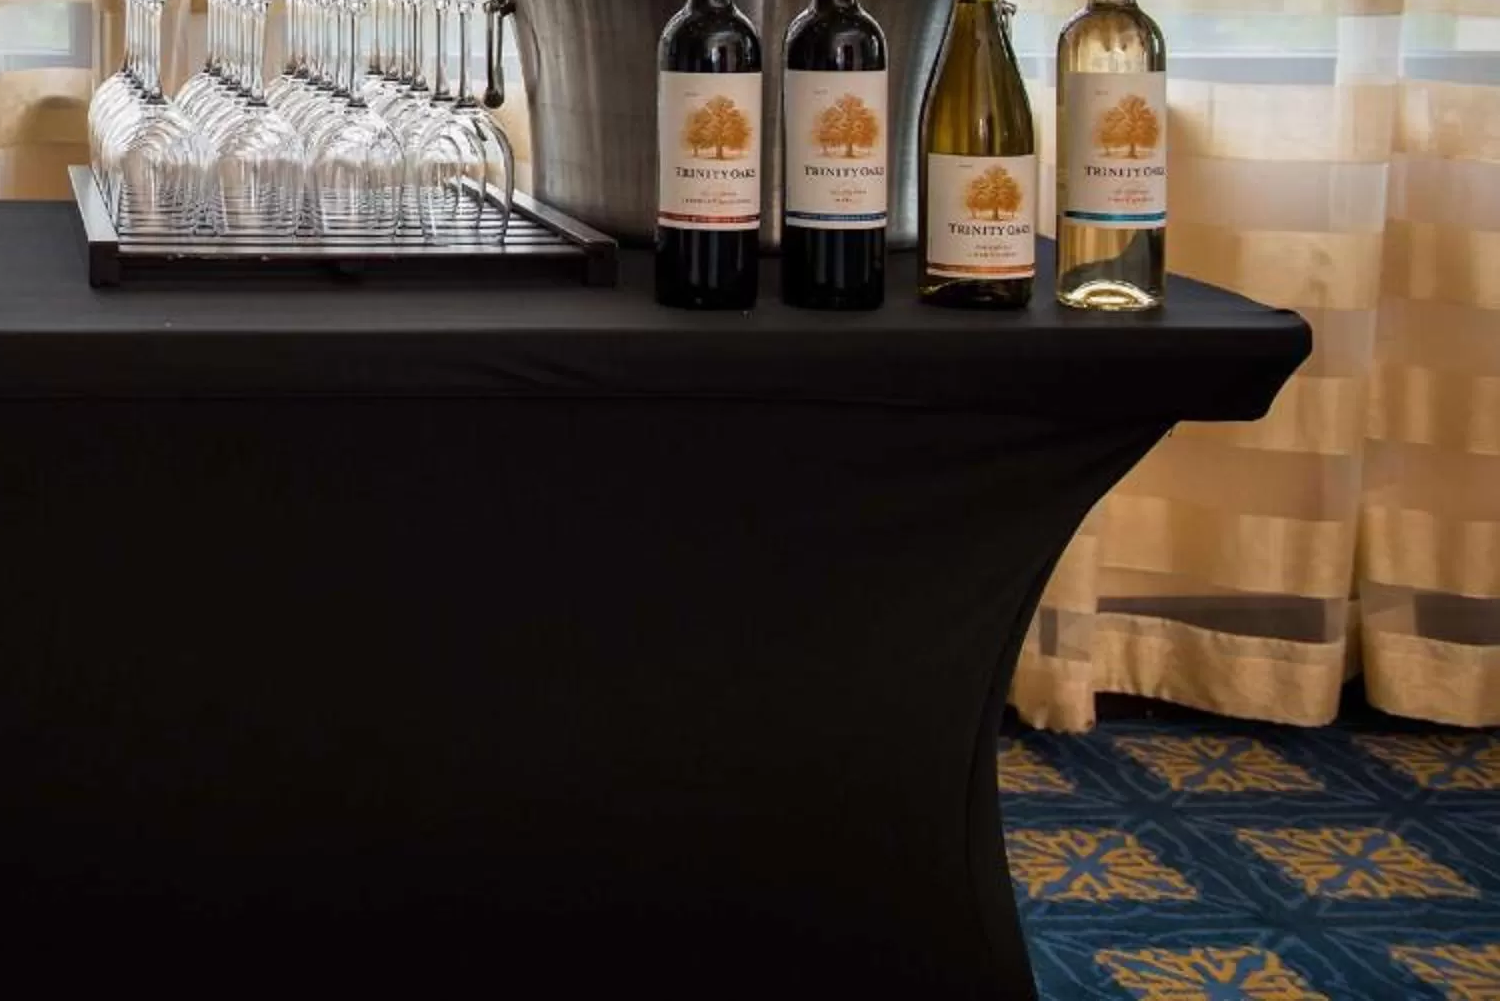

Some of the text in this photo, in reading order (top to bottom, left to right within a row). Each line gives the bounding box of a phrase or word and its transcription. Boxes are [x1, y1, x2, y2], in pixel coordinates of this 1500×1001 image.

[675, 167, 729, 179] TRINITY
[804, 165, 858, 177] TRINITY
[1084, 166, 1165, 178] TRINITY OA
[948, 223, 1005, 236] TRINITY
